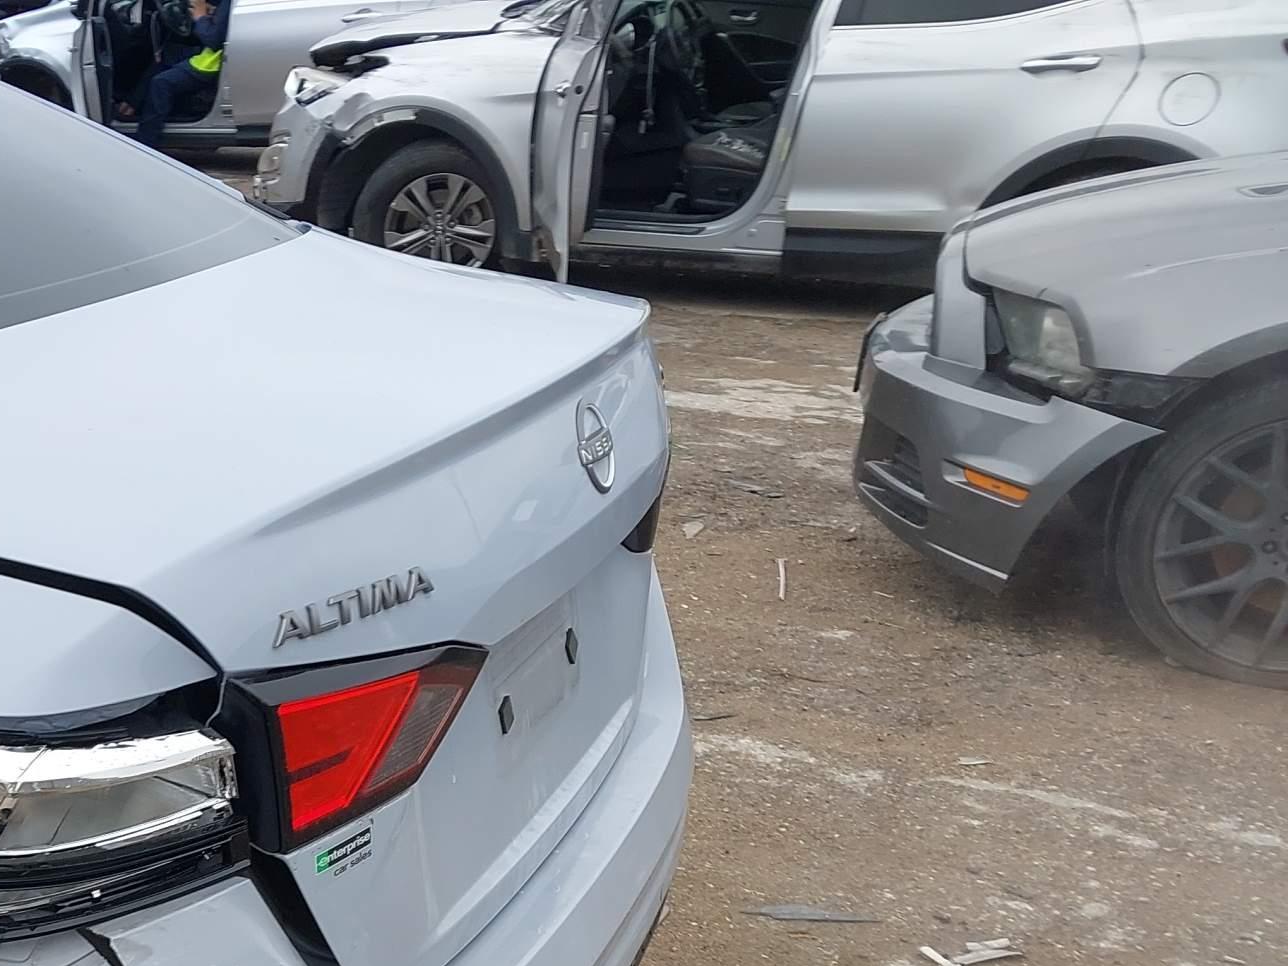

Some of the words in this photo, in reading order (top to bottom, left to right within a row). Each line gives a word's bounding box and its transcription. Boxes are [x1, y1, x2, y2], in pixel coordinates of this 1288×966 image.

[581, 437, 611, 463] NISS
[272, 567, 434, 648] ALTIMA
[318, 833, 370, 867] enterprise
[334, 863, 349, 876] car
[350, 849, 372, 867] sales
